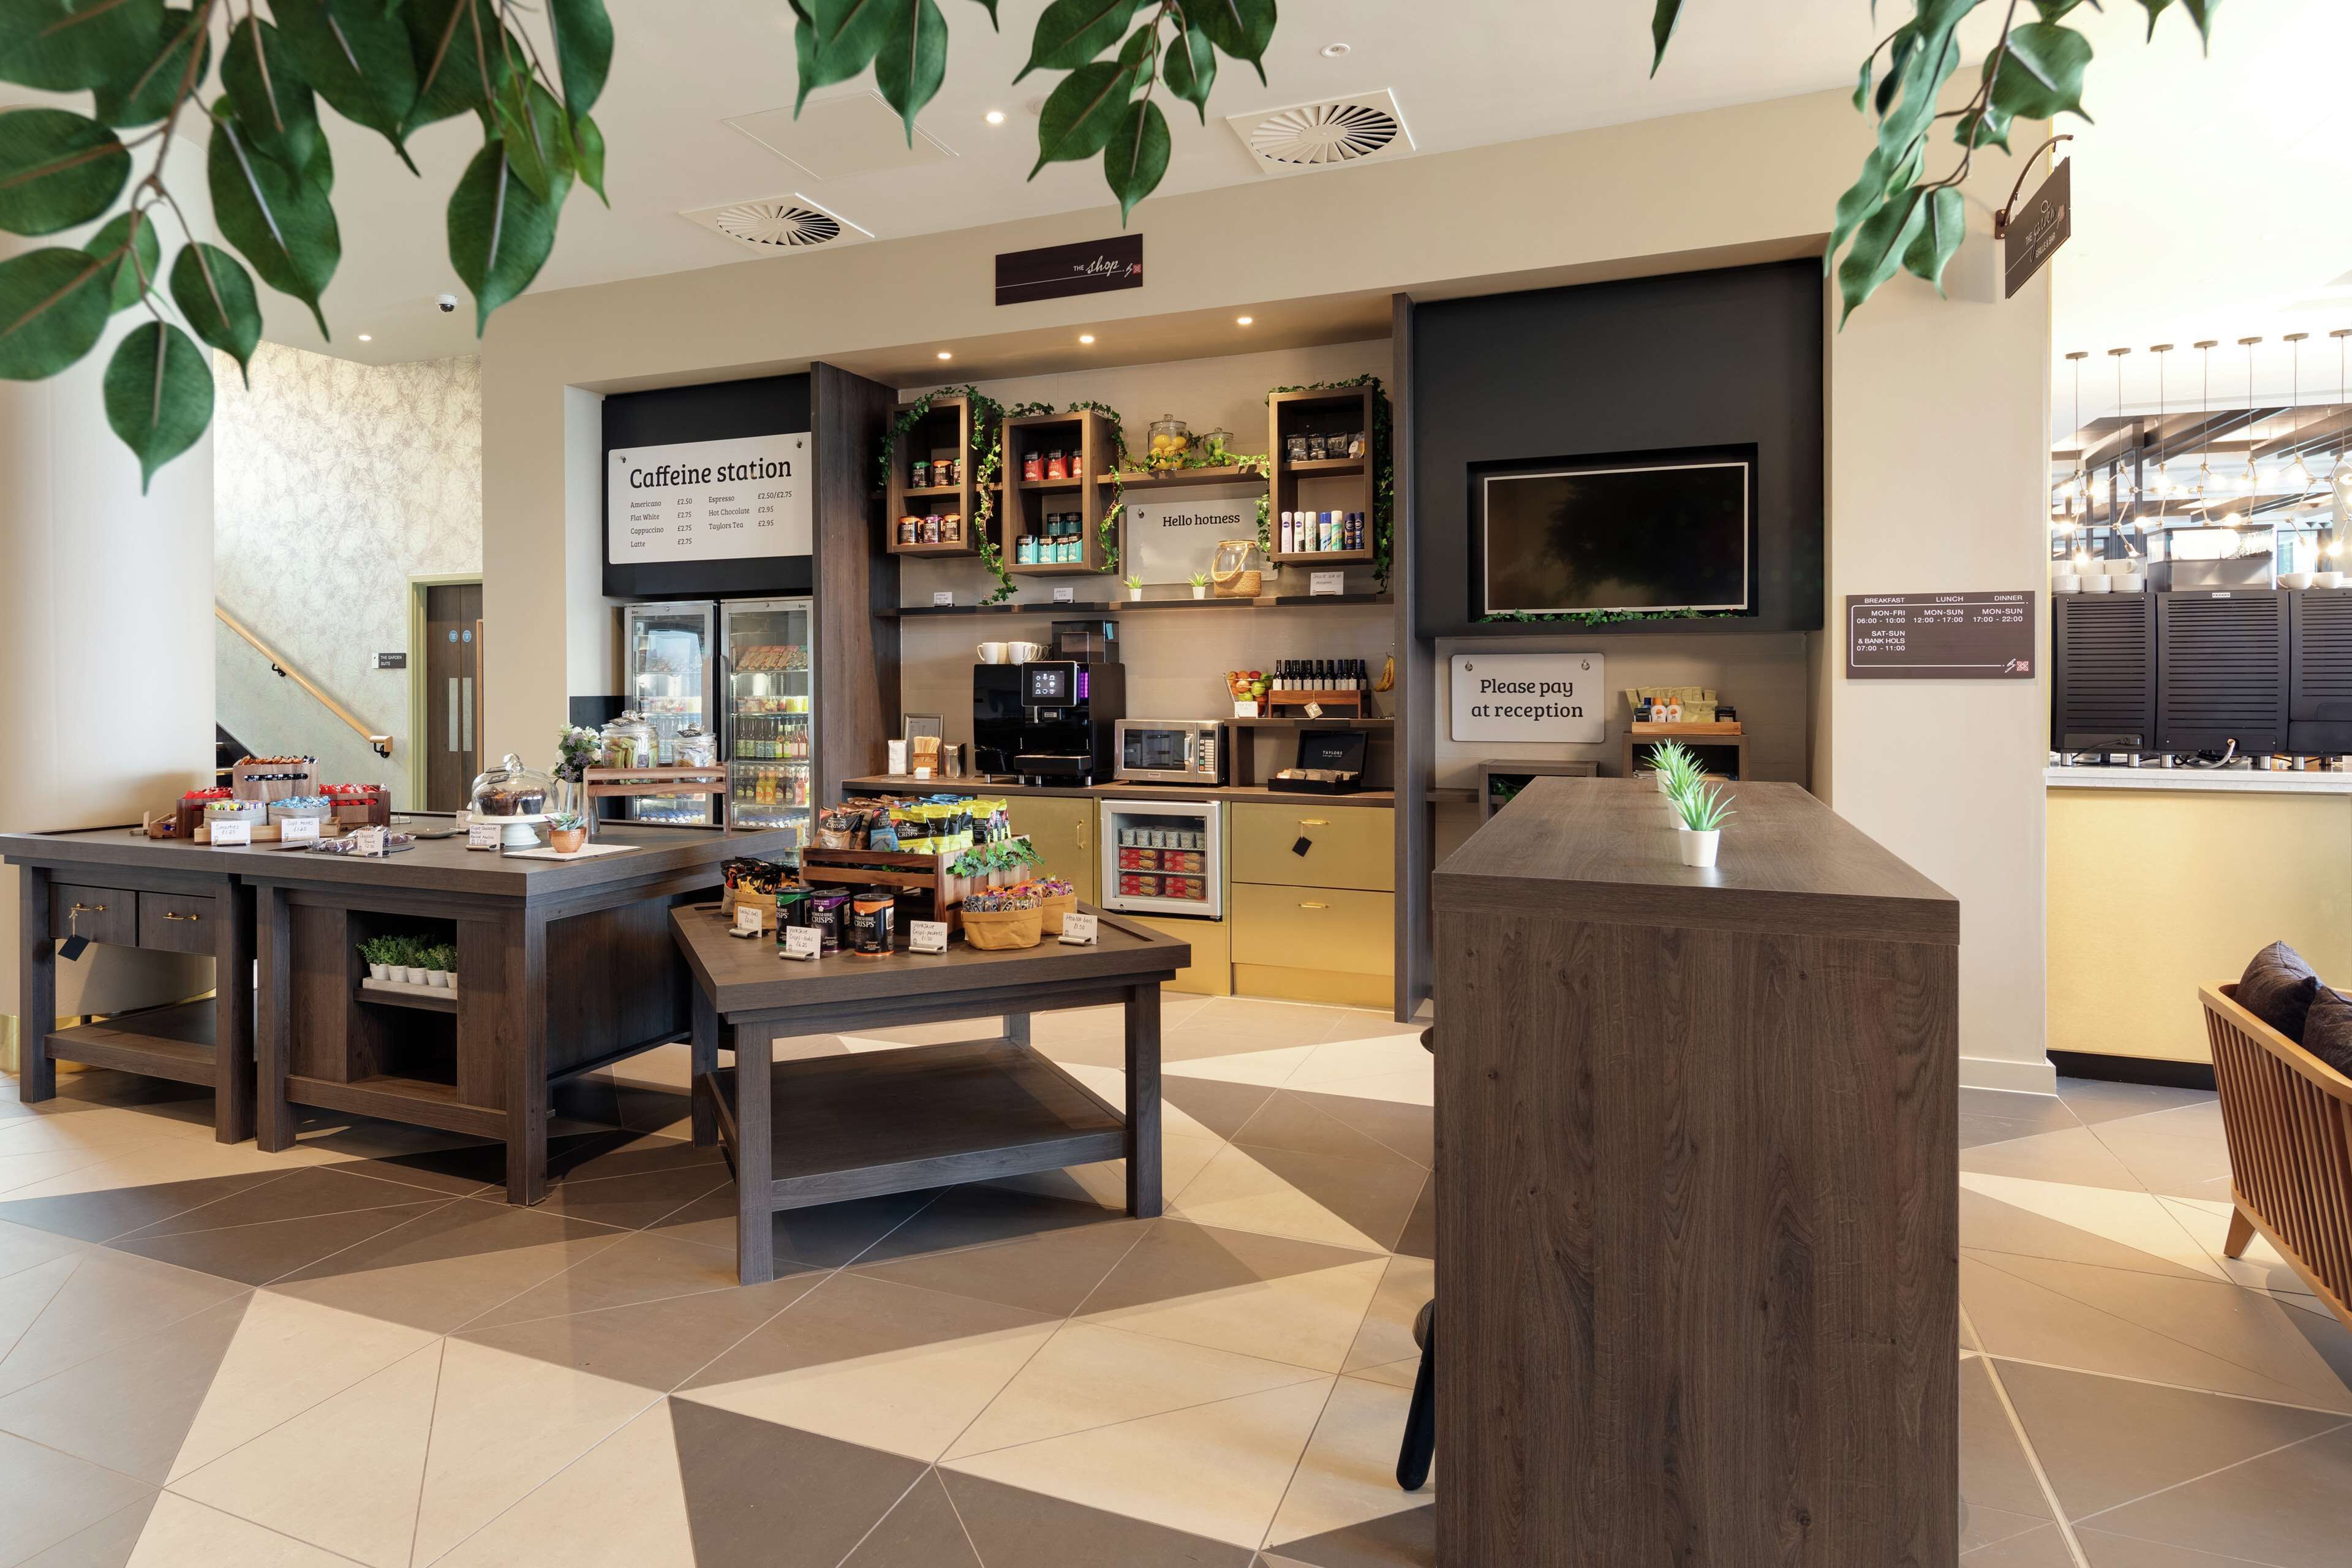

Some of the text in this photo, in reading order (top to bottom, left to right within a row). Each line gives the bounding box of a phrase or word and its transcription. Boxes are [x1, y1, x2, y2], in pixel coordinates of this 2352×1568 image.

[1085, 255, 1120, 277] shop
[630, 458, 792, 489] Caffeine station
[708, 491, 792, 504] Espresso £2.50/£2.75
[708, 522, 731, 531] Taylors
[1163, 514, 1240, 527] Hello hotness
[630, 526, 664, 535] Cappuccino
[1480, 679, 1573, 698] Please pay
[1471, 703, 1583, 722] at reception
